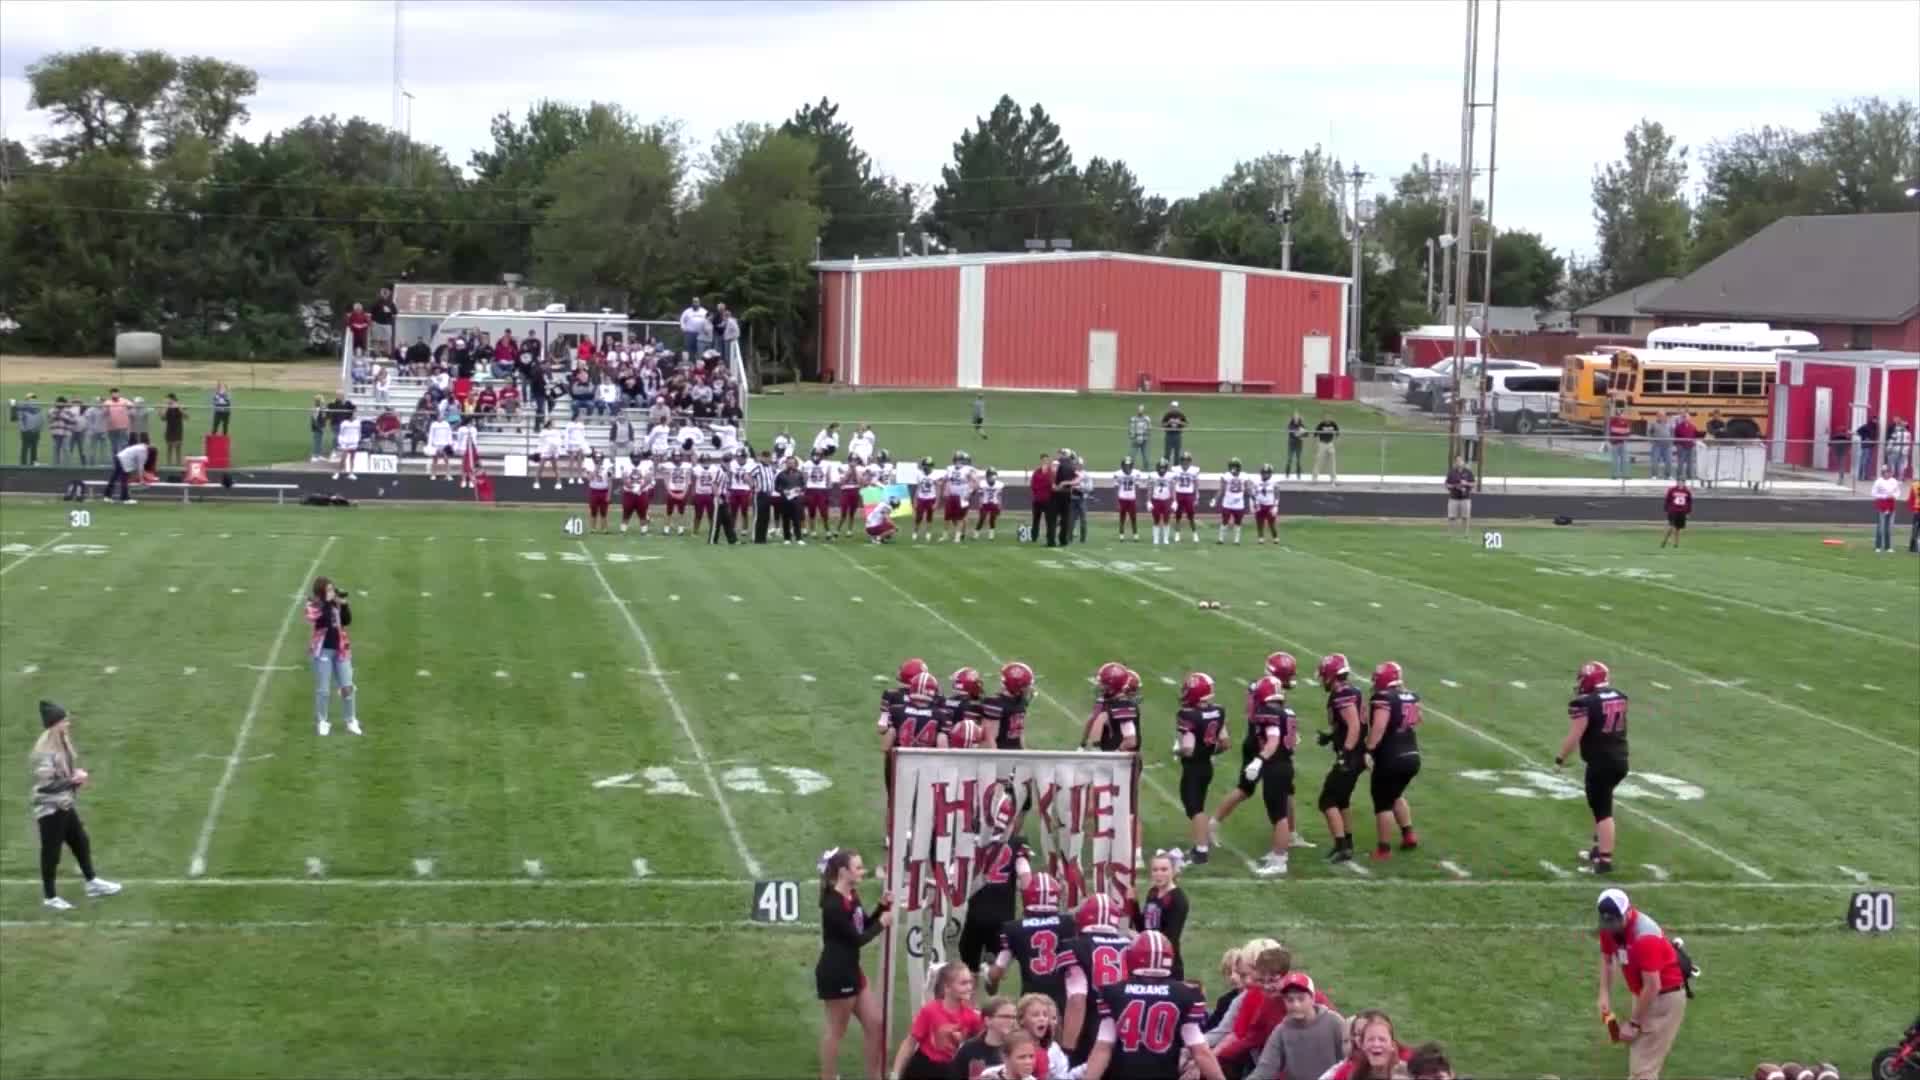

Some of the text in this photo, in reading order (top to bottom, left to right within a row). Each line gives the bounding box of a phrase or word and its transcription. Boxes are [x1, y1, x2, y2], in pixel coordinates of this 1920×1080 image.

[70, 509, 91, 528] 30
[564, 516, 583, 536] 40
[1484, 532, 1503, 549] 20
[900, 716, 938, 748] 44
[1602, 699, 1628, 733] 77
[758, 881, 800, 922] 40
[1854, 893, 1894, 932] 30
[1030, 929, 1058, 975] 3
[1091, 945, 1129, 991] 6
[1124, 983, 1170, 996] INDIANS
[1116, 999, 1181, 1053] 40
